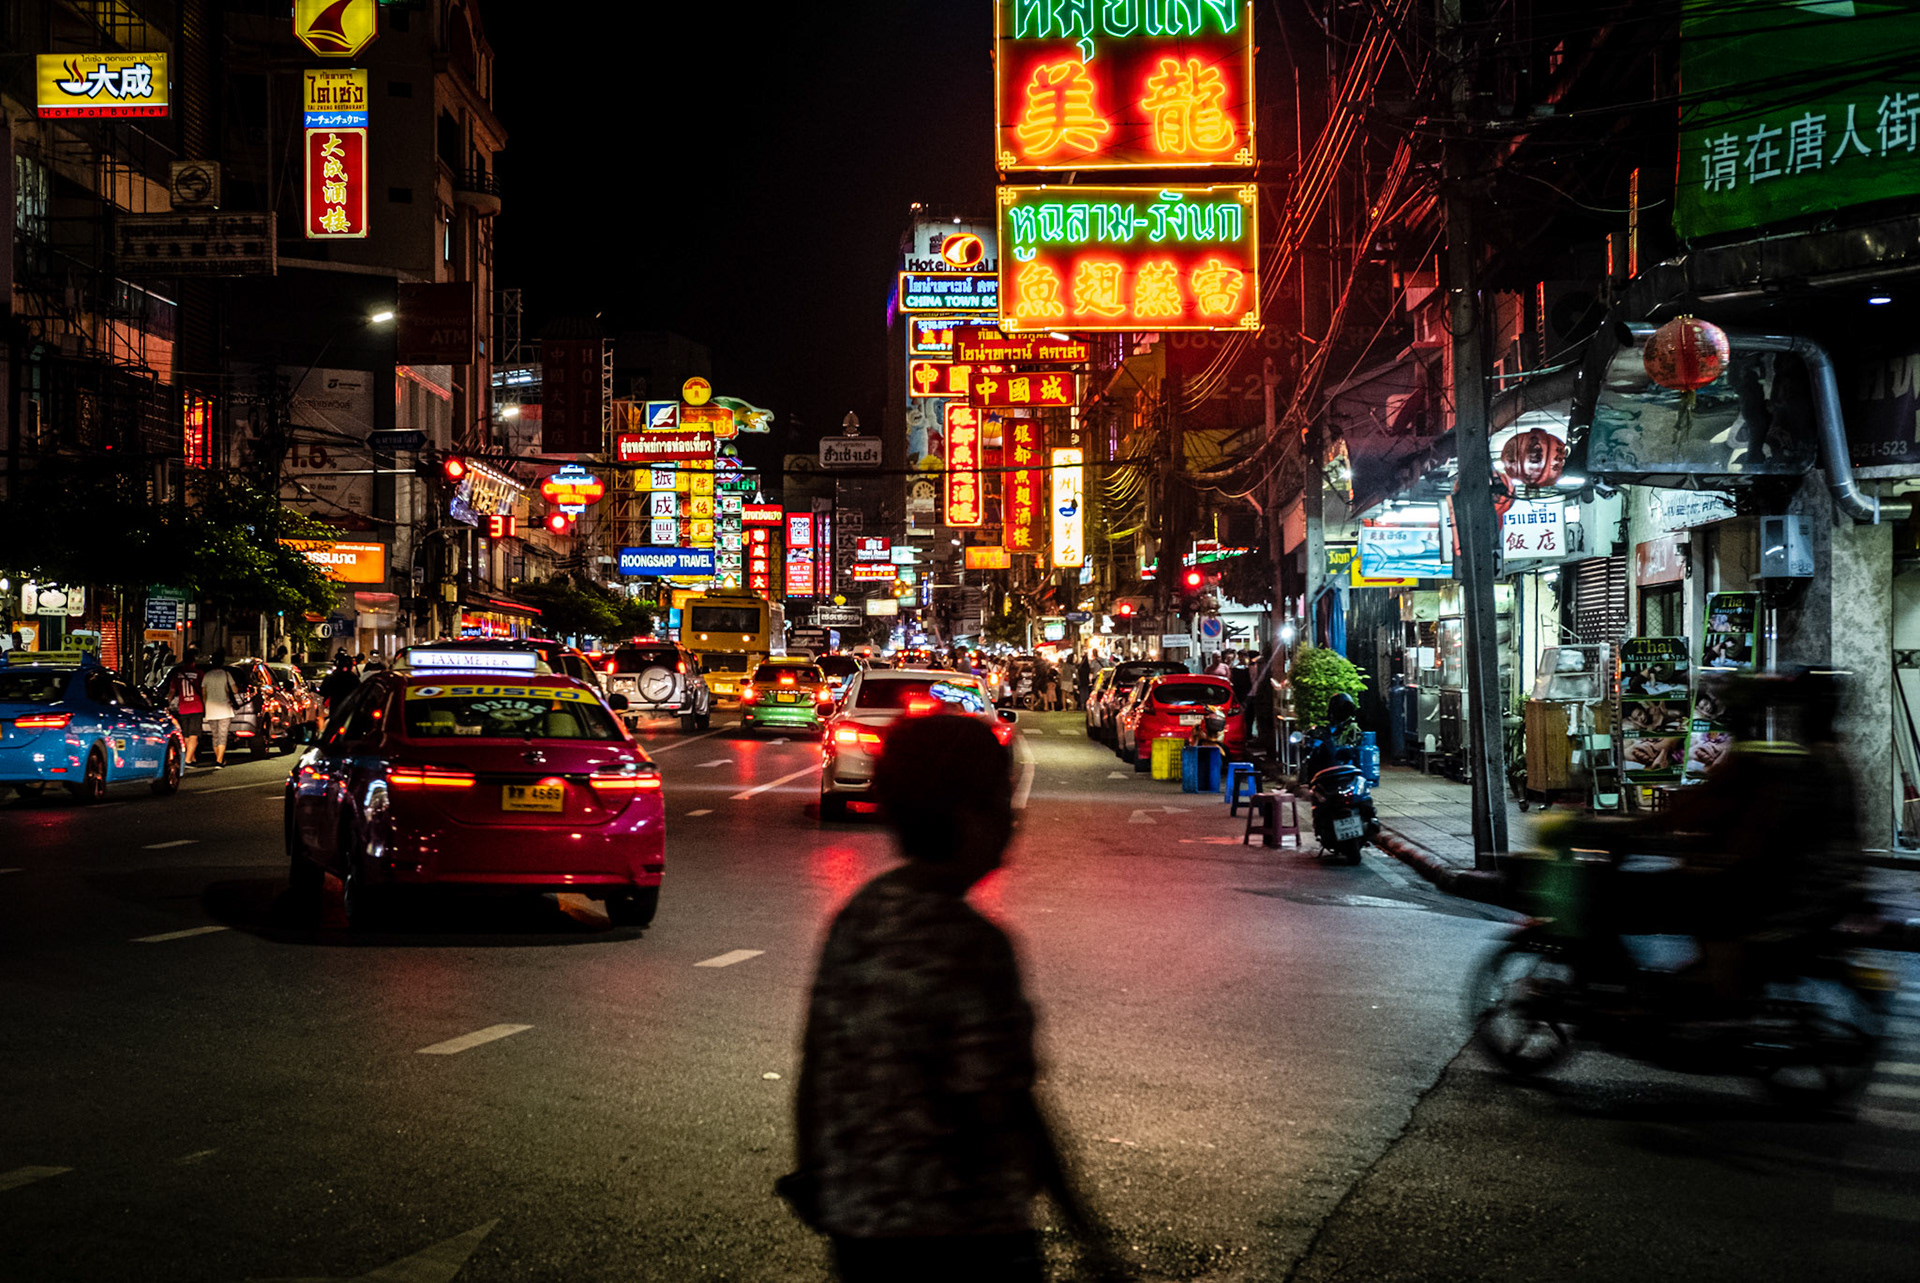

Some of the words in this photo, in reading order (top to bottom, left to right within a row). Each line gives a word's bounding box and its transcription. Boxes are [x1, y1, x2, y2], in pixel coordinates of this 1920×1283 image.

[87, 63, 153, 99] 大成
[43, 108, 69, 116] Hot
[77, 108, 102, 116] Pot
[111, 107, 163, 116] Buffet
[1018, 58, 1236, 155] 美龍
[1701, 92, 1920, 192] 请在唐人街
[1009, 190, 1243, 262] หูฉลาม-รังนก
[906, 296, 941, 307] CHINA
[946, 296, 979, 307] TOWN
[430, 330, 468, 344] ATM
[958, 342, 1033, 361] ไชน่าทาวน์
[582, 348, 593, 445] HOTEL
[975, 375, 1067, 405] 中國城
[1013, 424, 1033, 548] 銀都魚翅酒樓
[490, 515, 516, 537] 31
[1506, 529, 1556, 551] 飯店
[621, 555, 677, 567] ROONGSARP
[679, 555, 712, 567] TRAVEL
[1722, 596, 1745, 608] Thai
[1633, 639, 1673, 654] Thai
[1670, 654, 1686, 662] Spa
[451, 687, 580, 700] SUSCO
[471, 700, 547, 714] 93785
